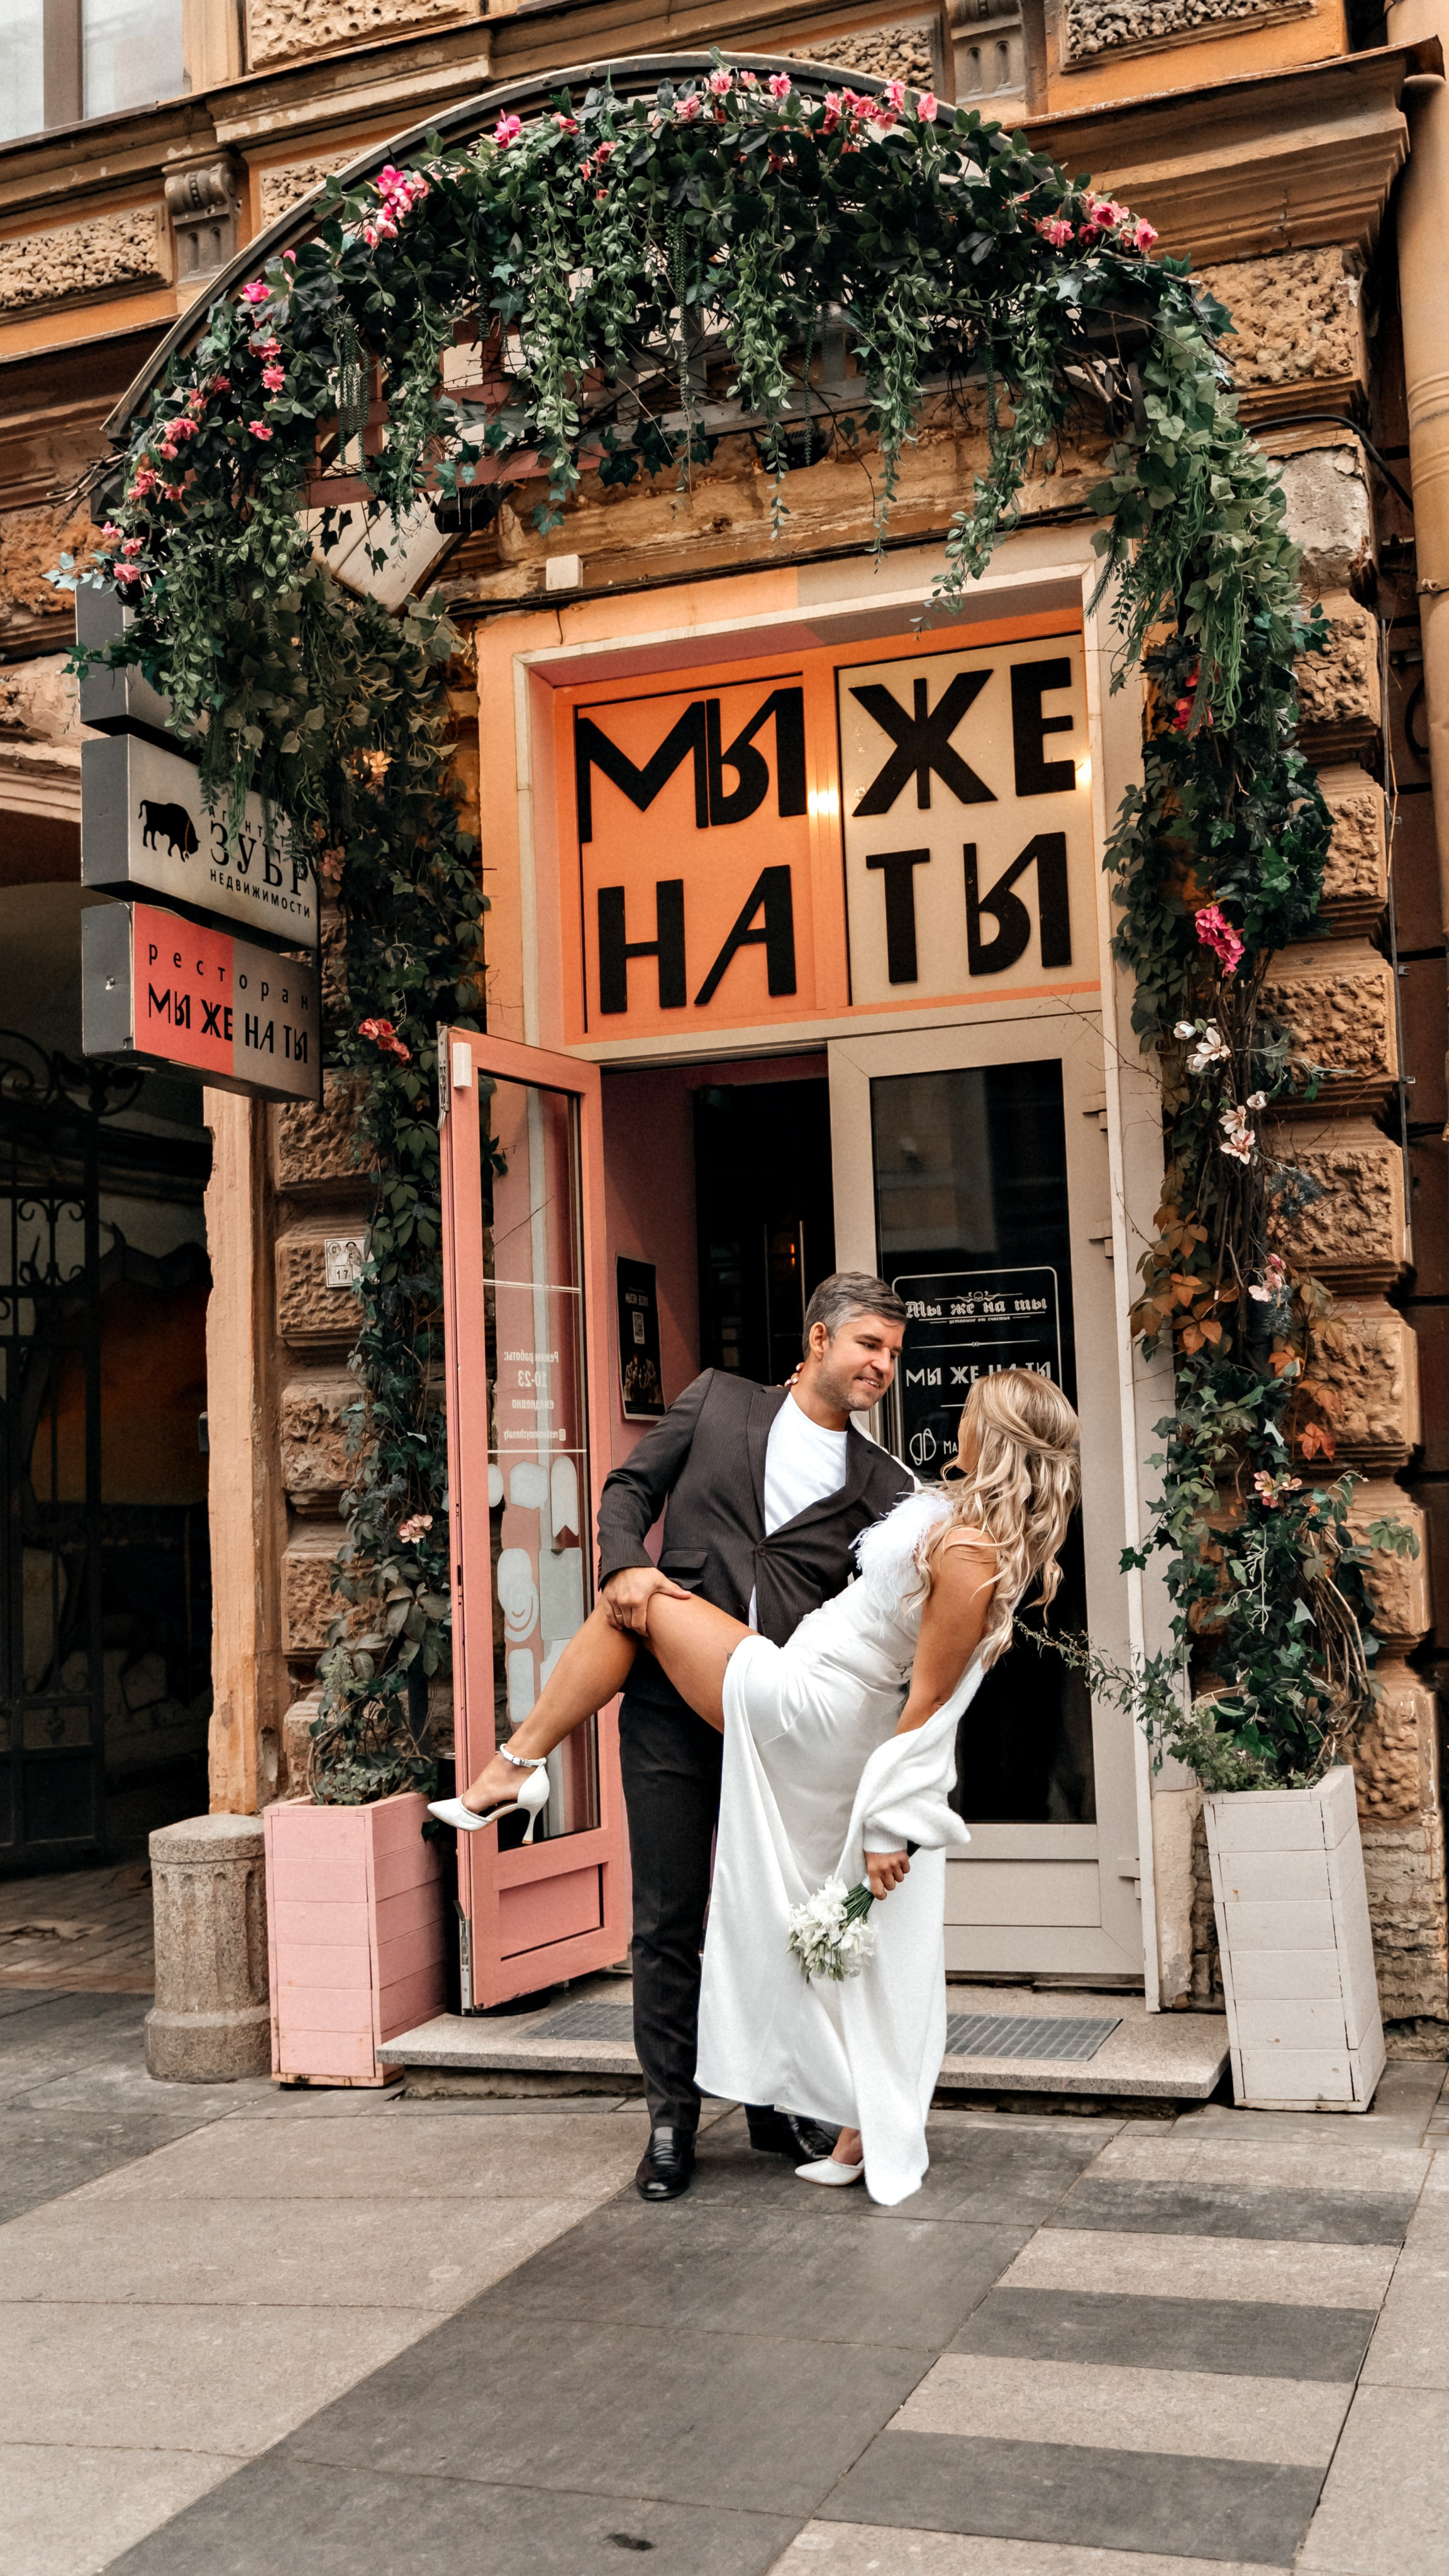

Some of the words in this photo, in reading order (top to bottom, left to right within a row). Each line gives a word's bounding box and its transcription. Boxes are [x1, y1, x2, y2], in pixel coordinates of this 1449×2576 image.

[848, 657, 1077, 818] ЖЕ
[210, 819, 309, 897] ЗУБР
[210, 869, 310, 918] НЕДВИЖИМОСТИ
[597, 864, 797, 1014] НА
[148, 943, 309, 1011] ресторан
[200, 998, 233, 1042] ЖЕ
[245, 1012, 274, 1054] НА
[905, 1301, 942, 1318] Мы
[950, 1302, 975, 1316] же
[983, 1301, 1006, 1314] на
[1014, 1298, 1048, 1311] ты
[950, 1365, 979, 1384] ЖЕ
